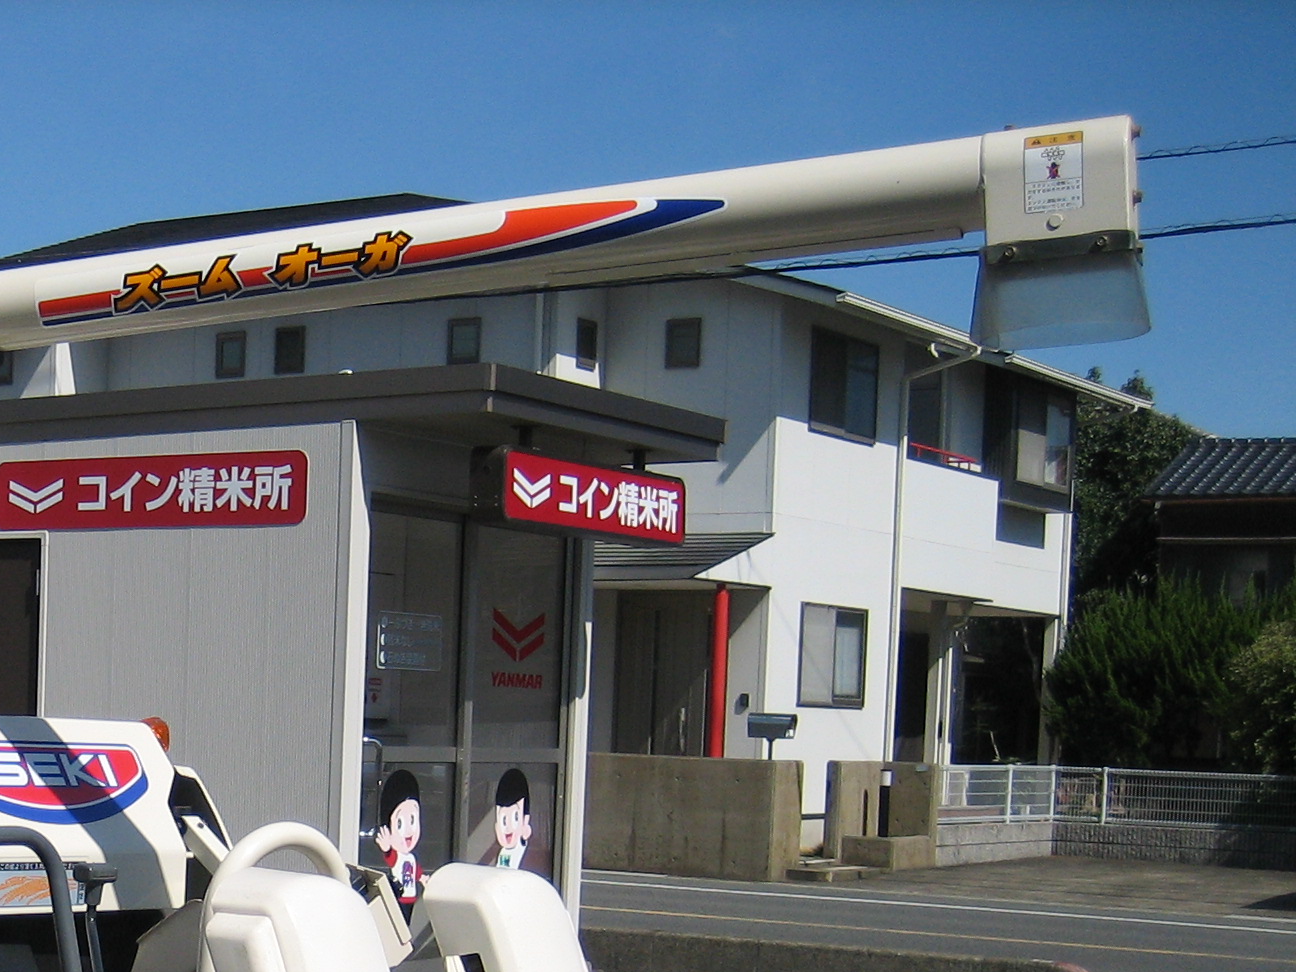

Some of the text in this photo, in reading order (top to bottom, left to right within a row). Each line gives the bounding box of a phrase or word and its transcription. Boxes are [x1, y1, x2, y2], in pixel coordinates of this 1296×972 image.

[114, 231, 412, 313] ズーム オーガ
[77, 464, 293, 513] コイン精米所
[559, 474, 679, 534] コイン精米所
[491, 671, 543, 689] YANMAR
